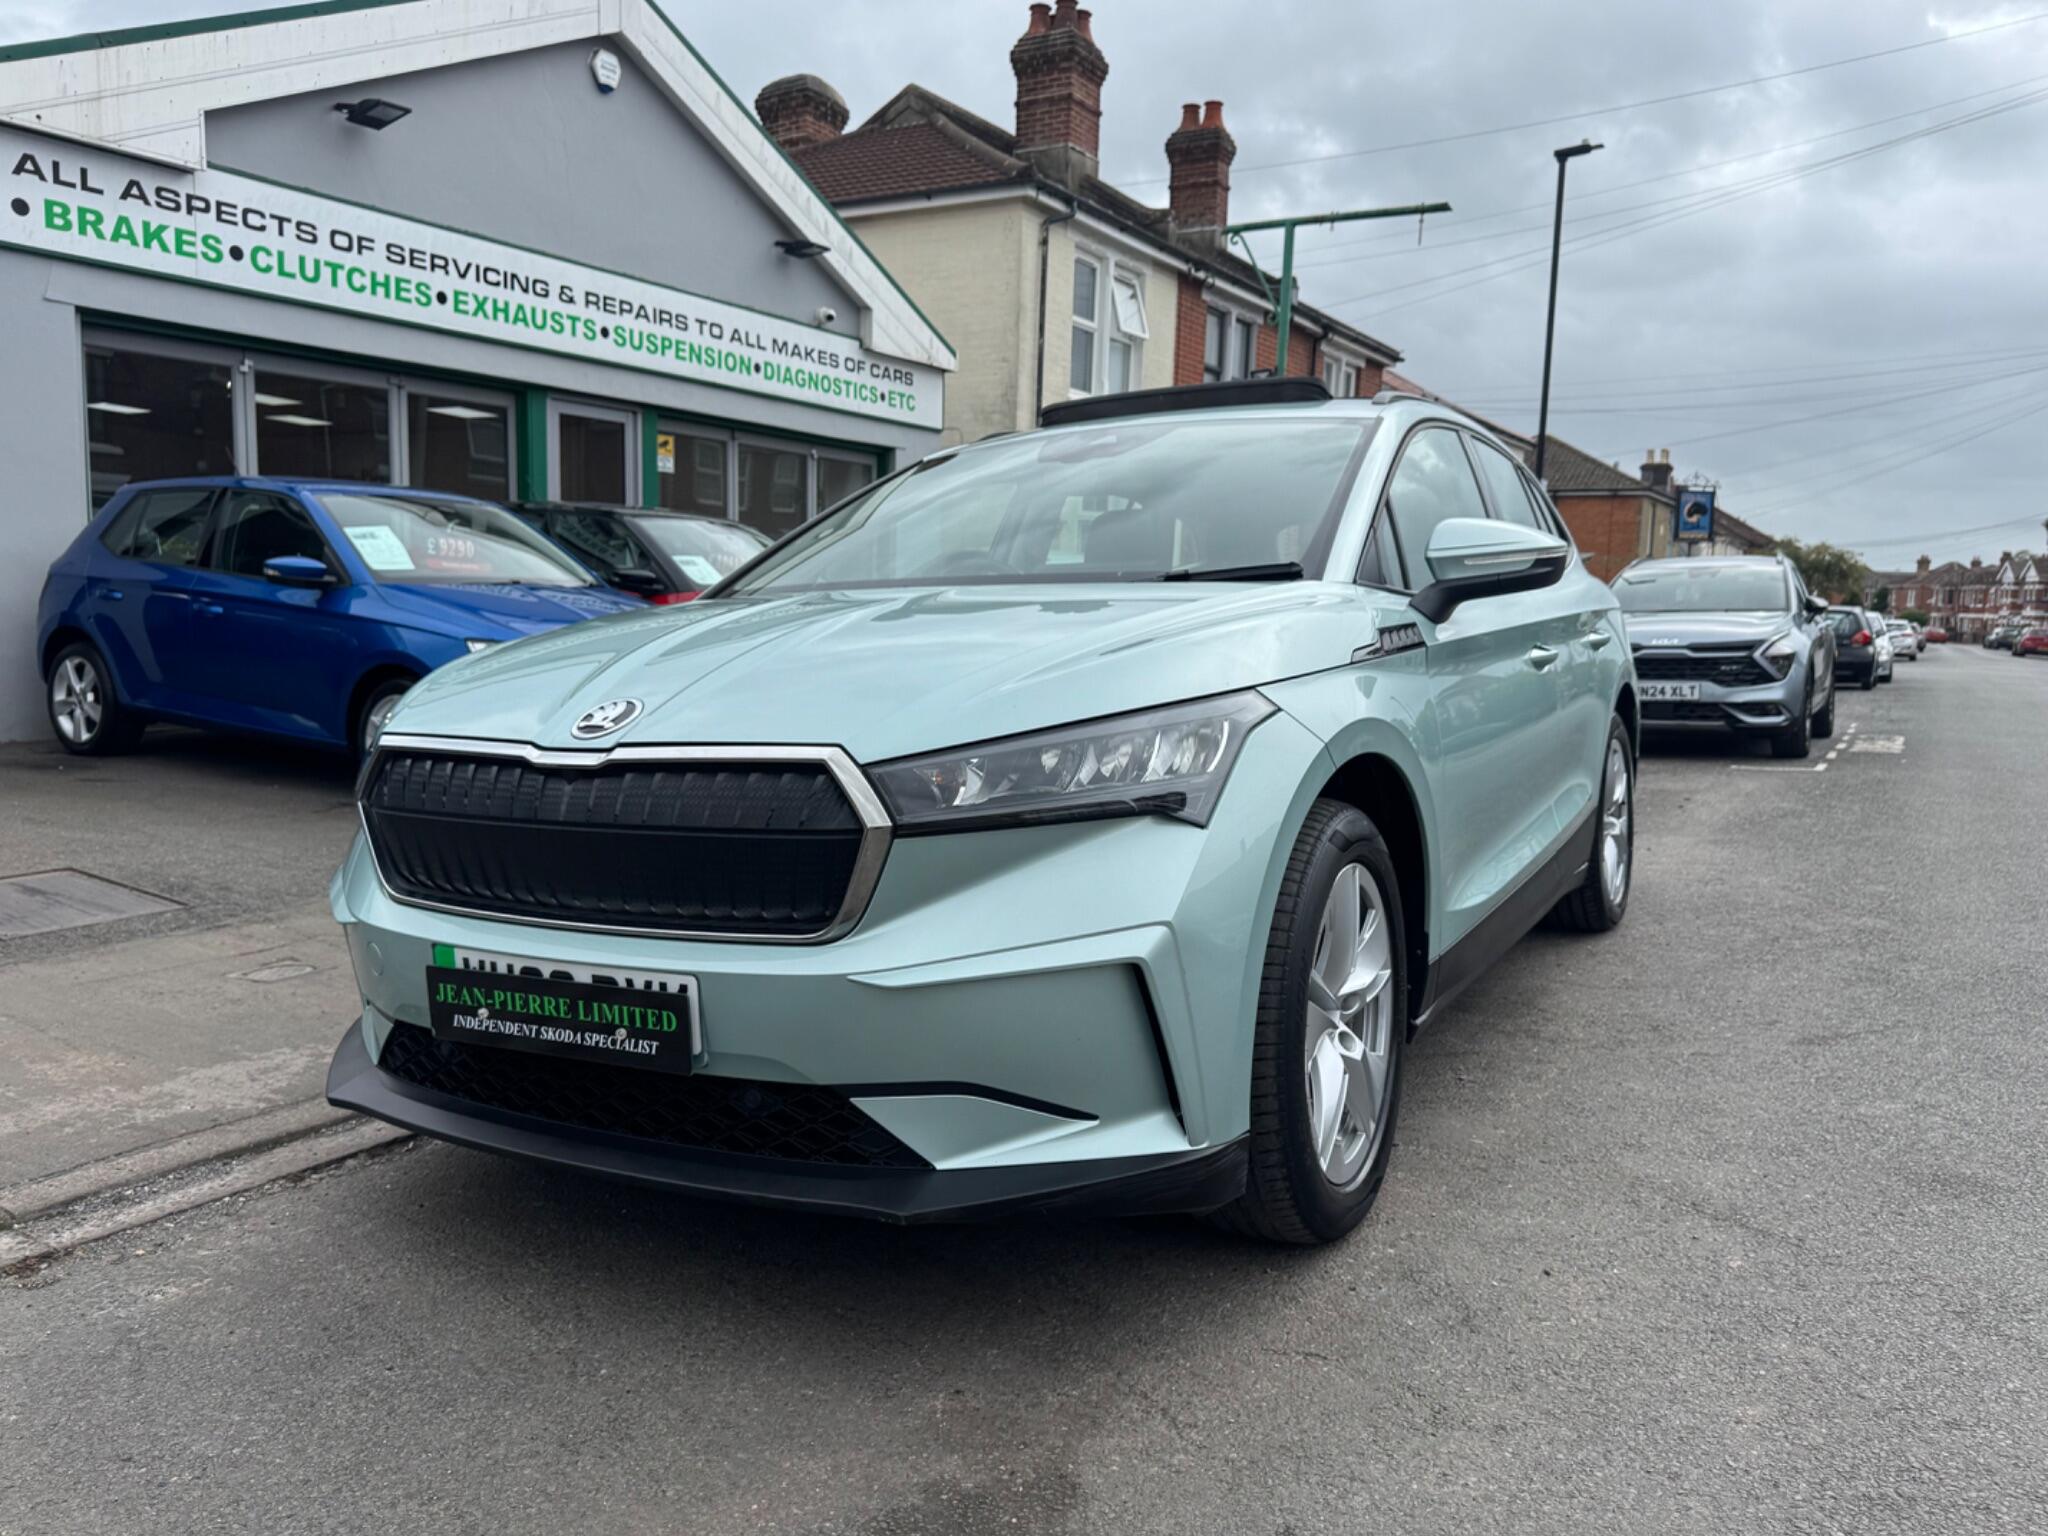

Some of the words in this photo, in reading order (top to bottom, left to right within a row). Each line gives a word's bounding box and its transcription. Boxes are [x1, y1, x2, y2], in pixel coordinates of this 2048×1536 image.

[11, 152, 105, 196] ALL
[118, 178, 318, 245] ASPECTS
[330, 228, 375, 256] OF
[385, 242, 550, 299] SERVICING
[558, 285, 576, 305] &
[585, 290, 689, 332] REPAIRS
[695, 318, 724, 341] TO
[729, 327, 767, 351] ALL
[772, 337, 840, 369] MAKES
[844, 356, 866, 374] OF
[870, 362, 914, 387] CARS
[43, 198, 225, 264] BRAKES
[250, 245, 433, 308] CLUTCHES
[453, 289, 598, 342] EXHAUSTS
[612, 324, 752, 377] SUSPENSION
[763, 360, 879, 405] DIAGNOSTICS
[887, 389, 917, 412] ETC
[1636, 685, 1666, 698] N24
[1670, 685, 1697, 698] XLT
[436, 983, 572, 1019] JEAN-PIERRE
[578, 1000, 678, 1032] LIMITED
[453, 1014, 539, 1038] INDEPENDENT
[540, 1025, 581, 1045] SKODA
[583, 1031, 660, 1056] SPECIALIST
